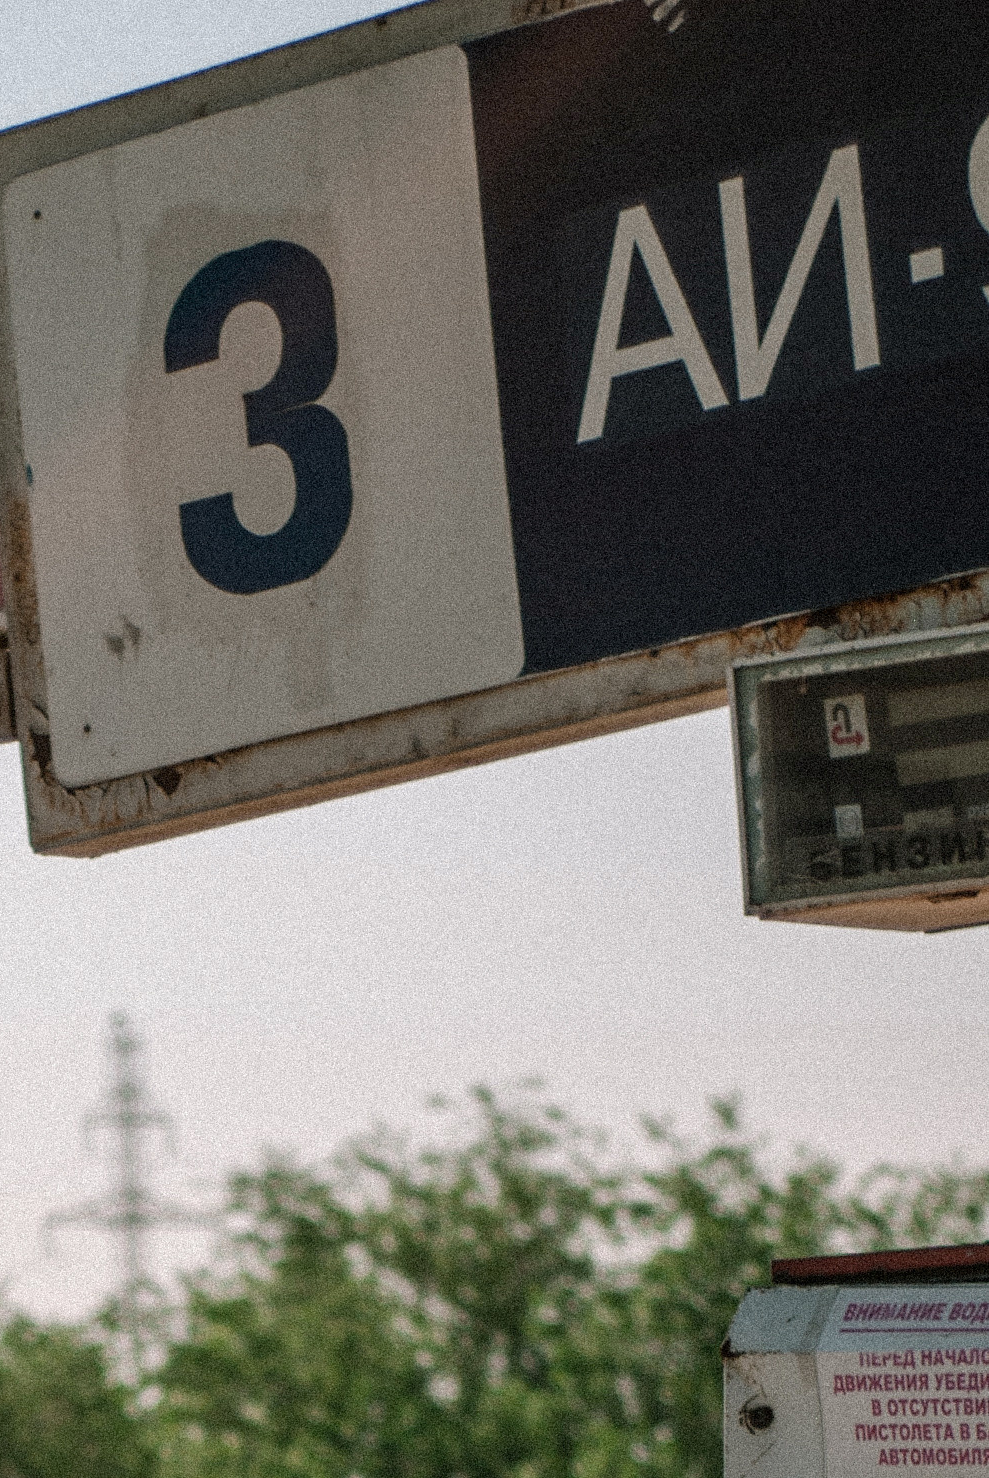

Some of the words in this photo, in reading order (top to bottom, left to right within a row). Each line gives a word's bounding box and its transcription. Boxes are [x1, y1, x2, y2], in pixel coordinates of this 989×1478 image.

[163, 239, 353, 595] 3
[577, 116, 989, 444] АИ-
[843, 1302, 947, 1322] ВНИМАНИЕ
[948, 1302, 989, 1325] ВОД
[859, 1348, 916, 1369] ПЕРЕД
[833, 1373, 929, 1396] ДВИЖЕНИЯ
[871, 1399, 882, 1416] В
[887, 1398, 989, 1417] ОТСУТСТВИ
[855, 1423, 954, 1441] ПИСТОЛЕТА
[960, 1423, 971, 1441] В
[975, 1423, 989, 1441] Б
